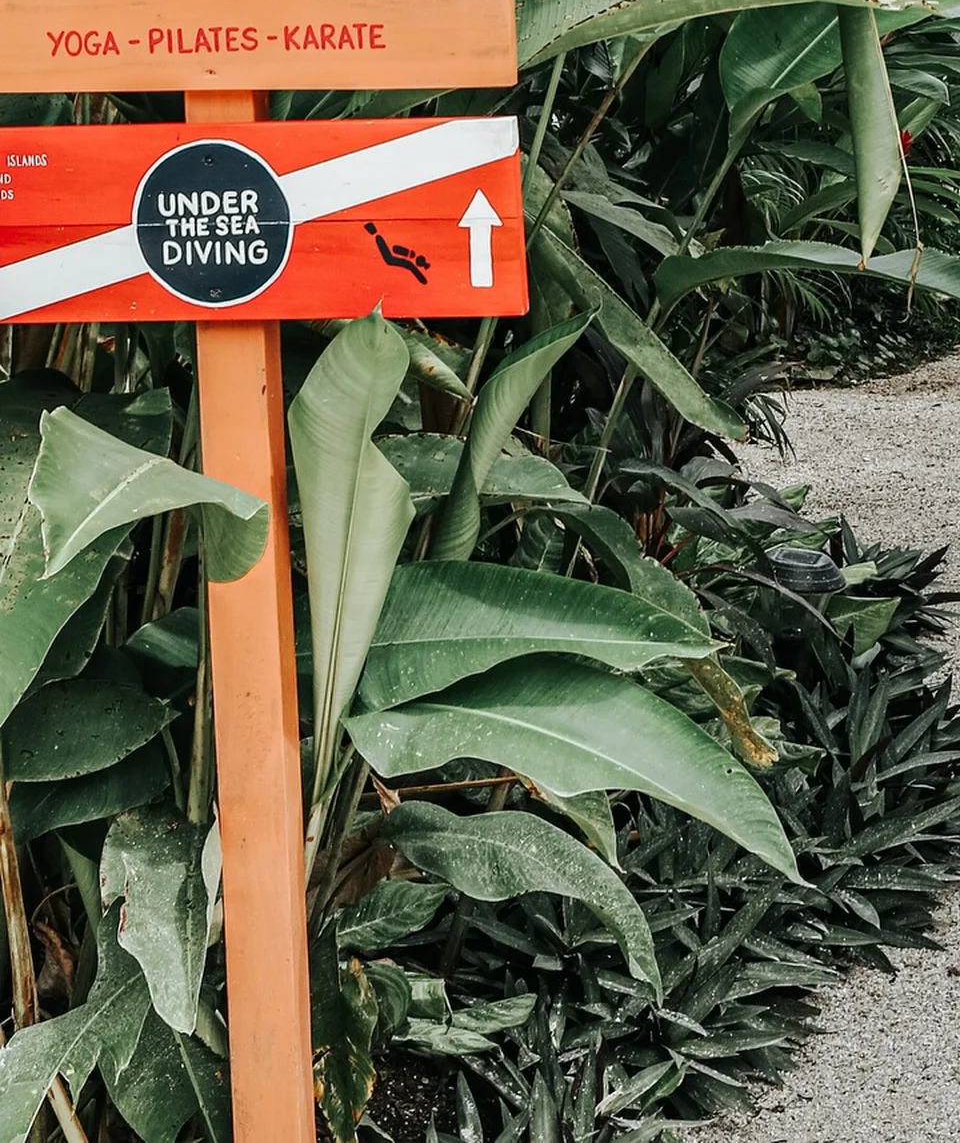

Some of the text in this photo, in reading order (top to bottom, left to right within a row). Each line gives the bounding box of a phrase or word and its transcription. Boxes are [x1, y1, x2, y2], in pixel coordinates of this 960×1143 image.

[46, 30, 120, 57] YOGA
[148, 27, 258, 54] PILATES
[284, 23, 386, 51] KARATE
[7, 153, 48, 167] ISLANDS
[158, 190, 259, 217] UNDER
[165, 215, 260, 237] THE SEA
[162, 239, 269, 266] DIVING
